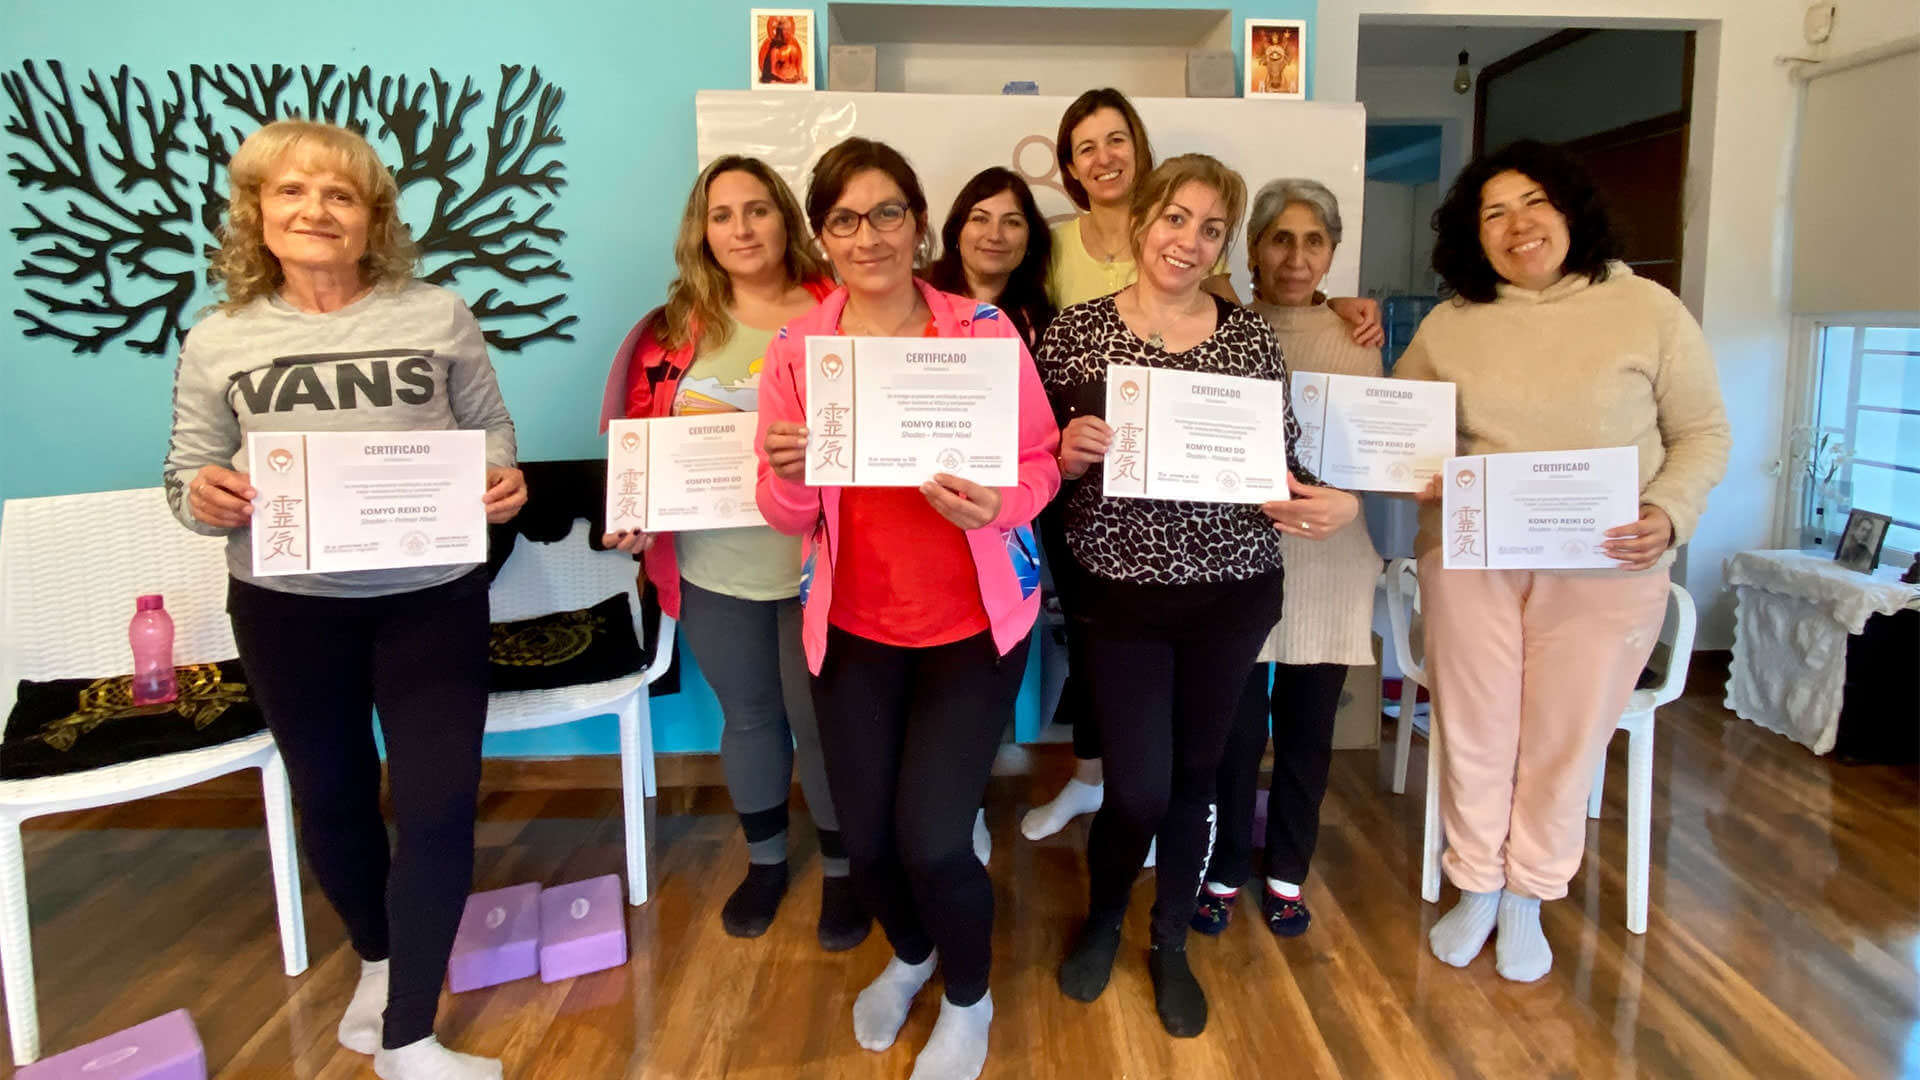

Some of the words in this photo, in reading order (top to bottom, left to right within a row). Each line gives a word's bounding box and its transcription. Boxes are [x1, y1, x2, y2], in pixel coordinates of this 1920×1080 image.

[906, 352, 967, 364] CERTIFICADO
[236, 350, 435, 414] VANS
[1191, 384, 1241, 399] CERTIFICADO
[1365, 388, 1413, 400] CERTIFICADO
[689, 424, 736, 435] CERTIFICADO
[901, 420, 933, 429] KOMYO
[935, 420, 957, 429] REIKI
[959, 420, 972, 429] DO
[364, 444, 431, 456] CERTIFICADO
[1186, 443, 1213, 452] KOMYO
[1234, 447, 1246, 455] DO
[1532, 462, 1590, 473] CERTIFICADO
[360, 507, 396, 516] KOMYO
[398, 506, 421, 514] REIKI
[423, 505, 437, 513] DO
